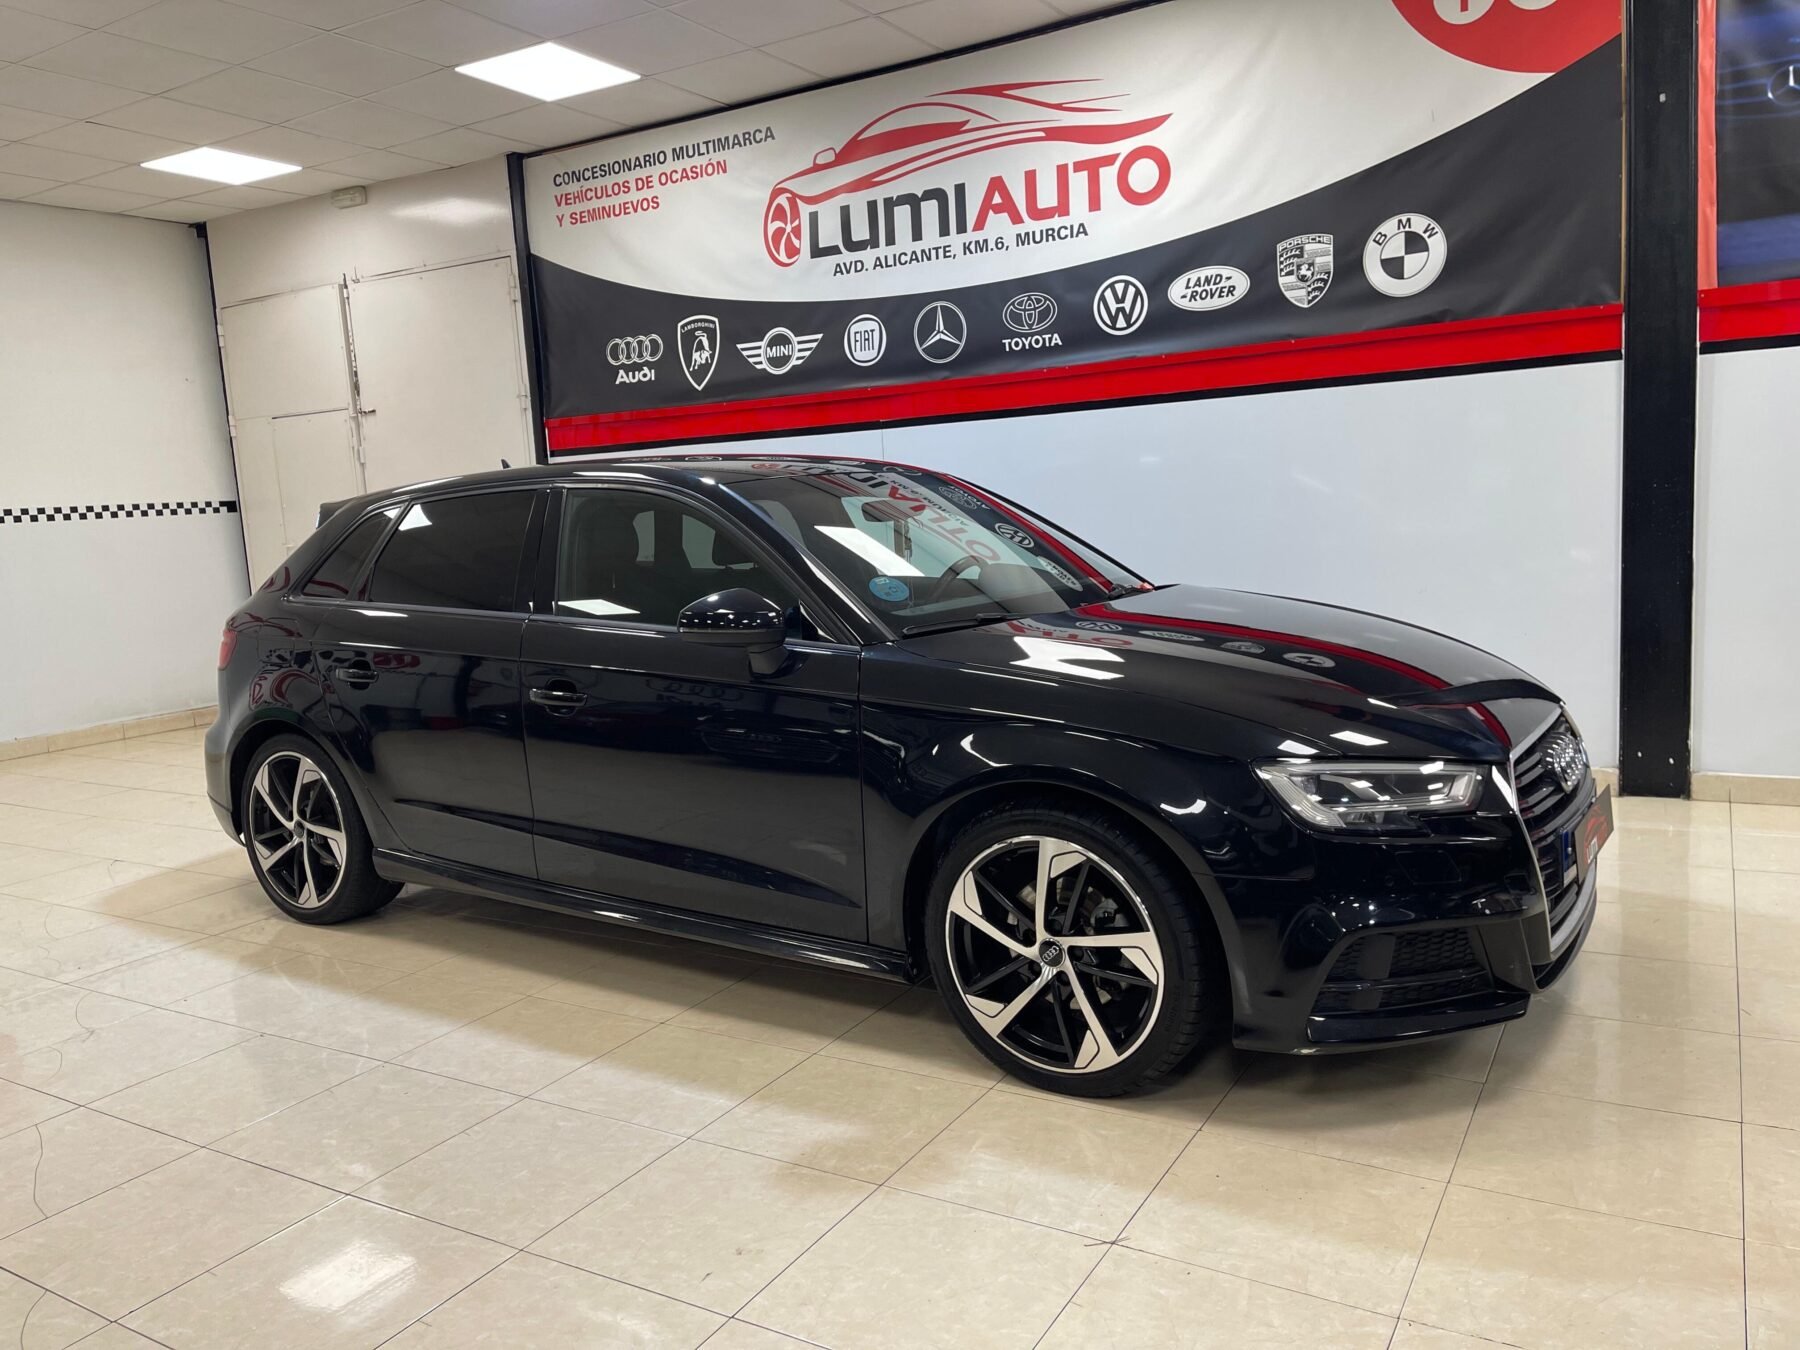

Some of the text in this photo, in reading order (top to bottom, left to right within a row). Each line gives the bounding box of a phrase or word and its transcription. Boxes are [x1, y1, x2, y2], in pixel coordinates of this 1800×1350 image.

[553, 126, 776, 187] CONCESIONARIO MULTIMARCA
[554, 158, 728, 207] VEHÍCULOS DE OCASIÓN
[556, 195, 660, 228] Y SEMINUEVOS
[833, 222, 1089, 277] AVD. ALICANTE, KM.6, MURCIA
[1278, 235, 1332, 252] PORSCHE
[766, 345, 793, 359] MINI
[853, 328, 876, 353] FIAT
[1002, 333, 1063, 352] TOYOTA
